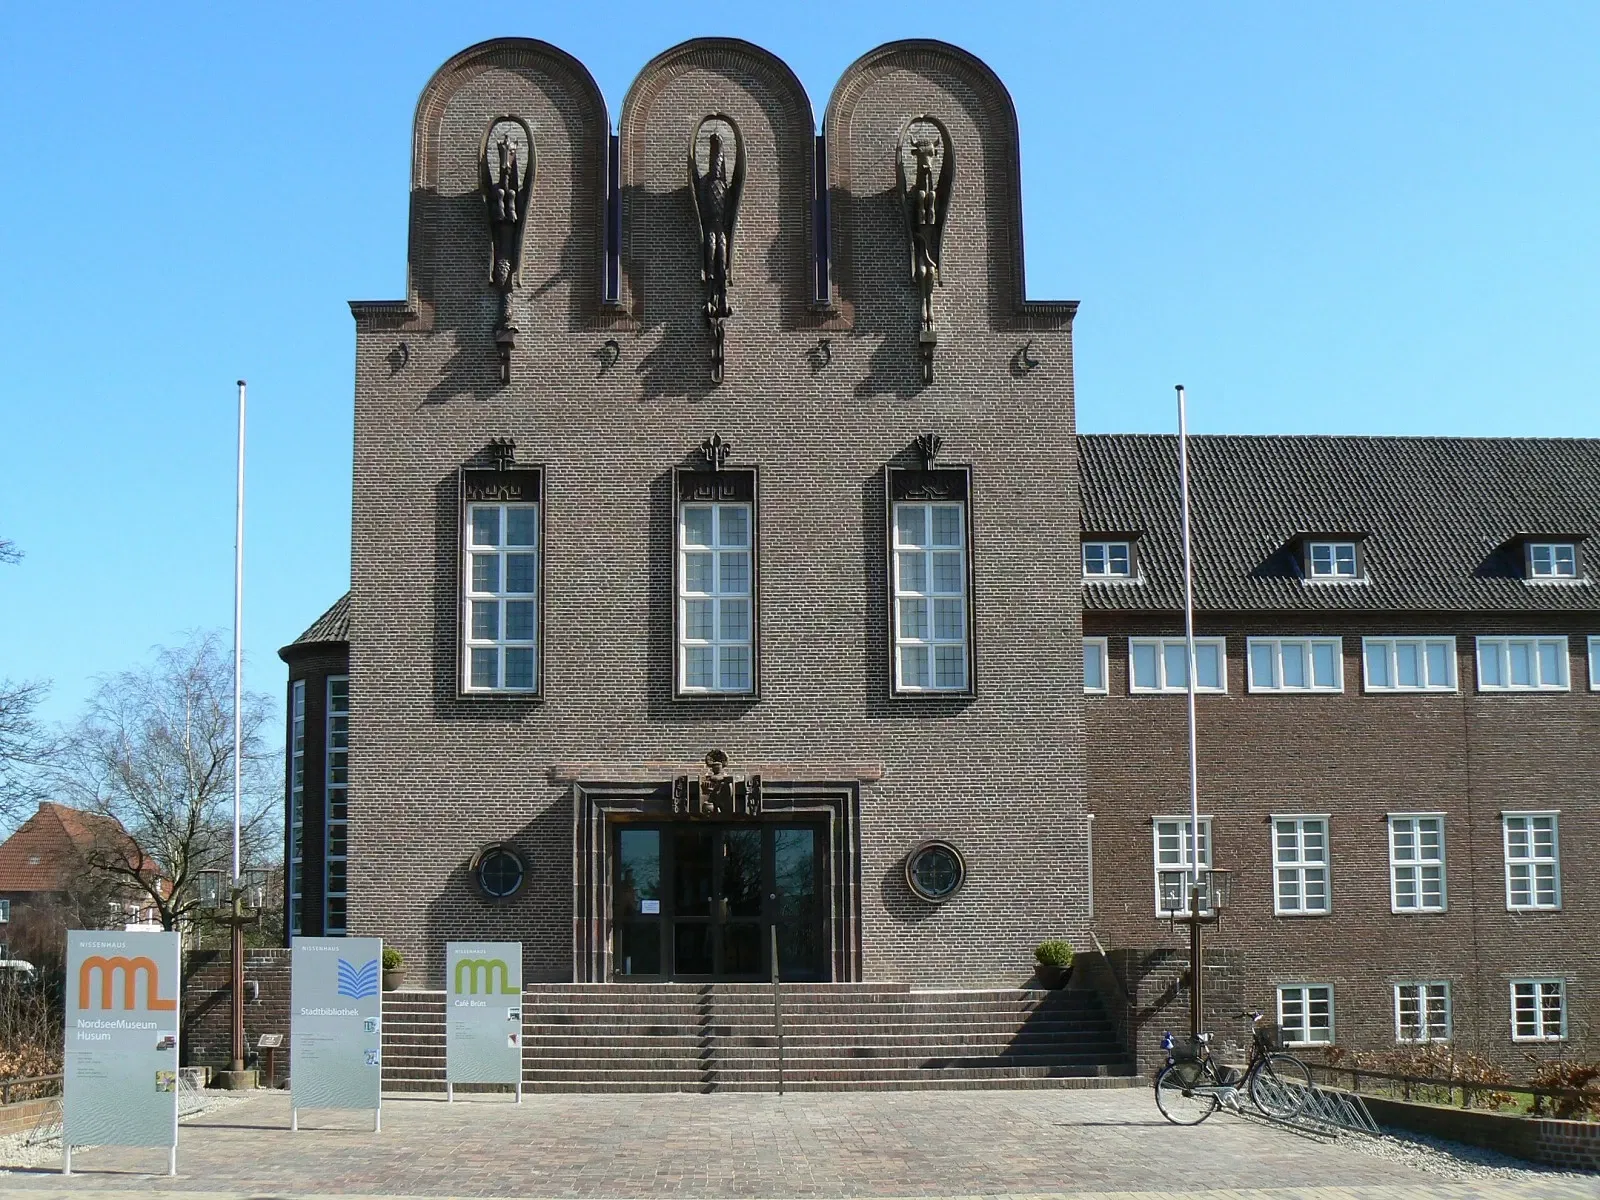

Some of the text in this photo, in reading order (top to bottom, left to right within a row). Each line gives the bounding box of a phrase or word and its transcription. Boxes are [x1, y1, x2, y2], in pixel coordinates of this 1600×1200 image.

[301, 1007, 360, 1016] Stadtbibliothek
[77, 1019, 158, 1030] NordseeMuseum
[77, 1032, 111, 1041] Husum
